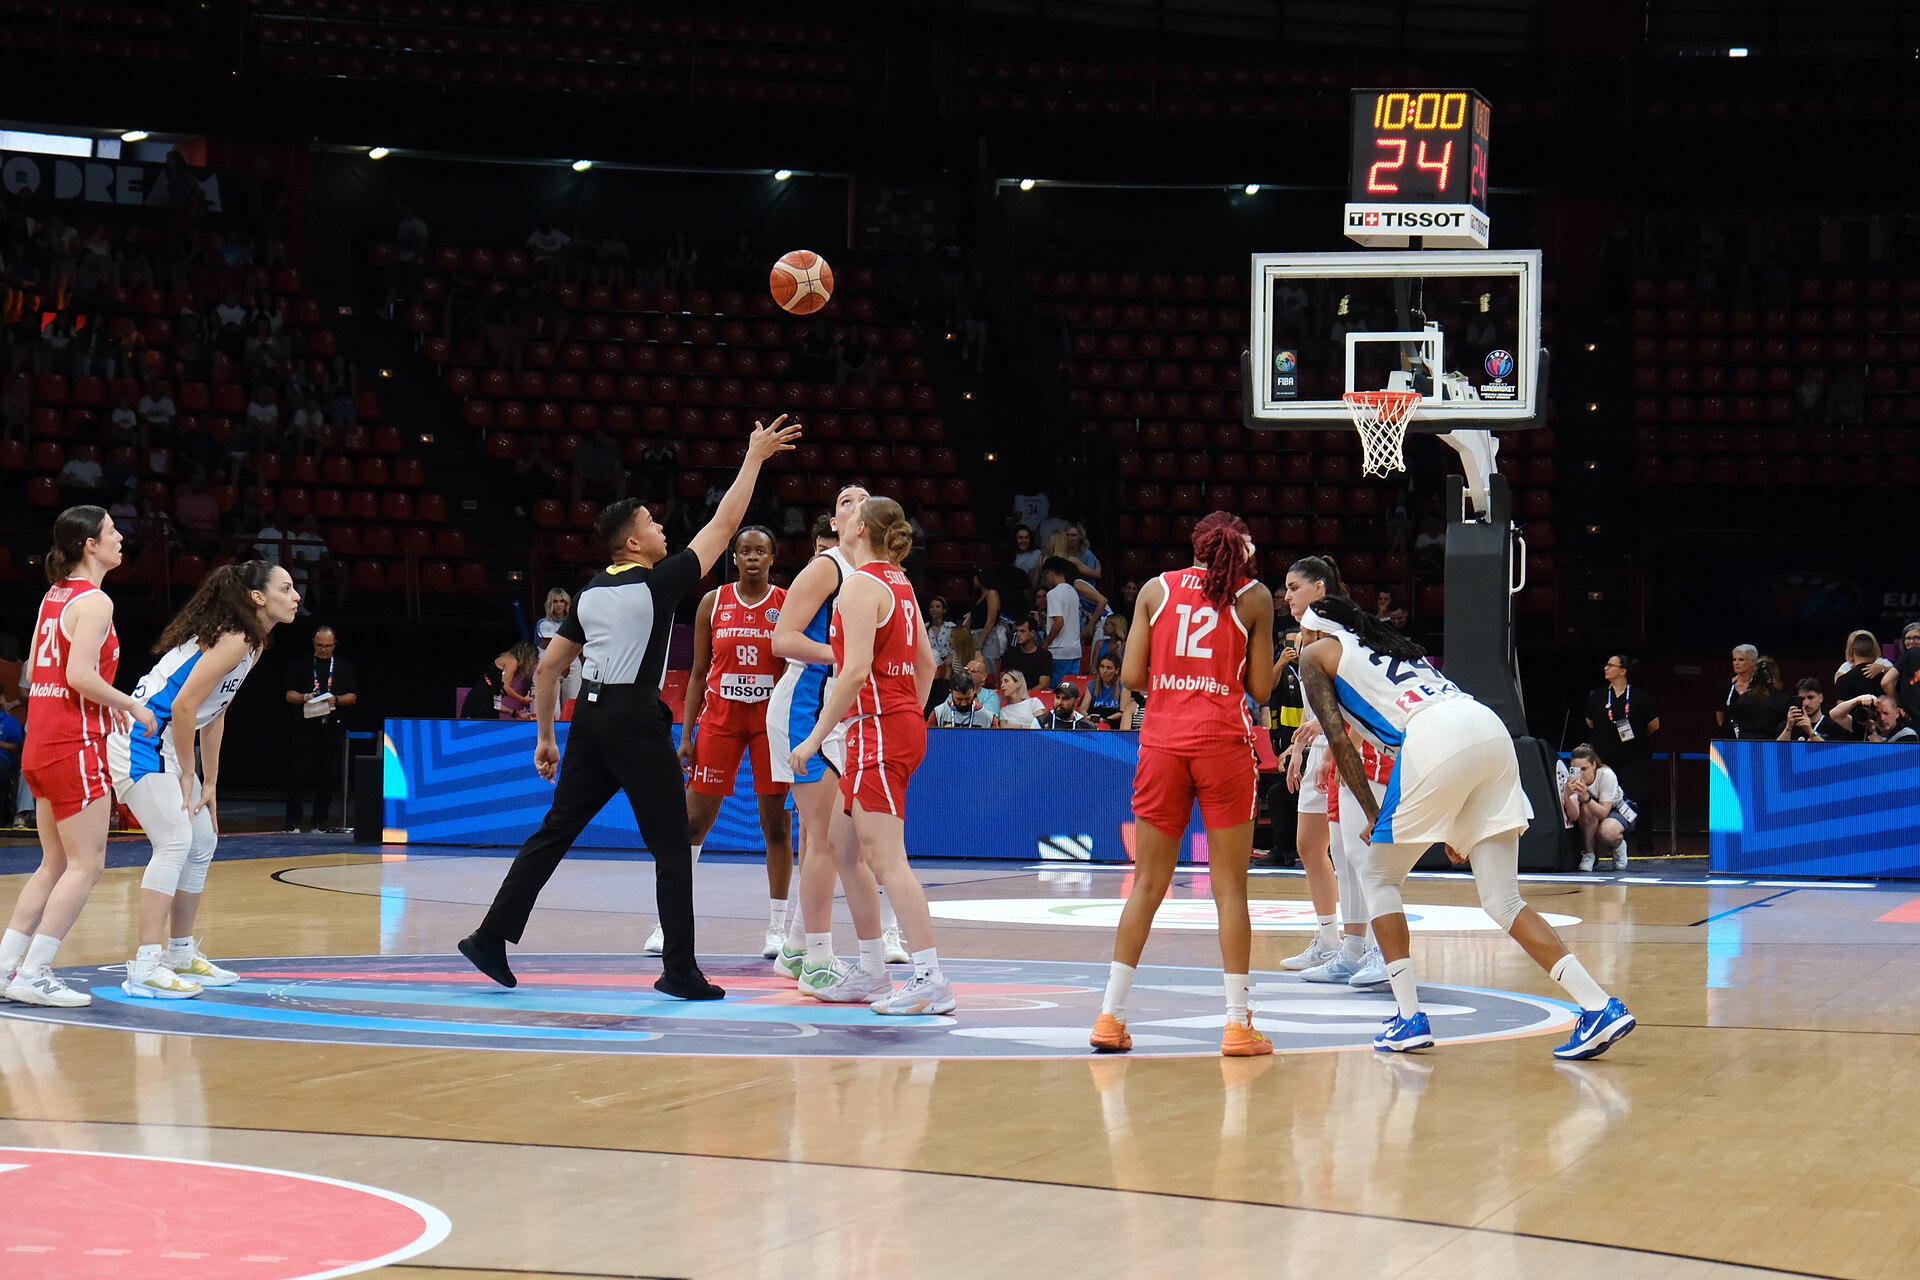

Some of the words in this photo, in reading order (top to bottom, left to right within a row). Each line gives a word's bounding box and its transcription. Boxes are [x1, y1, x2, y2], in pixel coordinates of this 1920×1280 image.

[1373, 92, 1467, 130] 10:00
[1366, 138, 1453, 193] 24
[1382, 212, 1465, 227] TISSOT
[1277, 377, 1294, 386] FIBA
[1884, 592, 1920, 608] EU
[1175, 603, 1219, 659] 12
[36, 618, 61, 668] 24
[736, 645, 759, 666] 98
[721, 685, 774, 697] TISSOT
[1159, 674, 1230, 696] Mobilière
